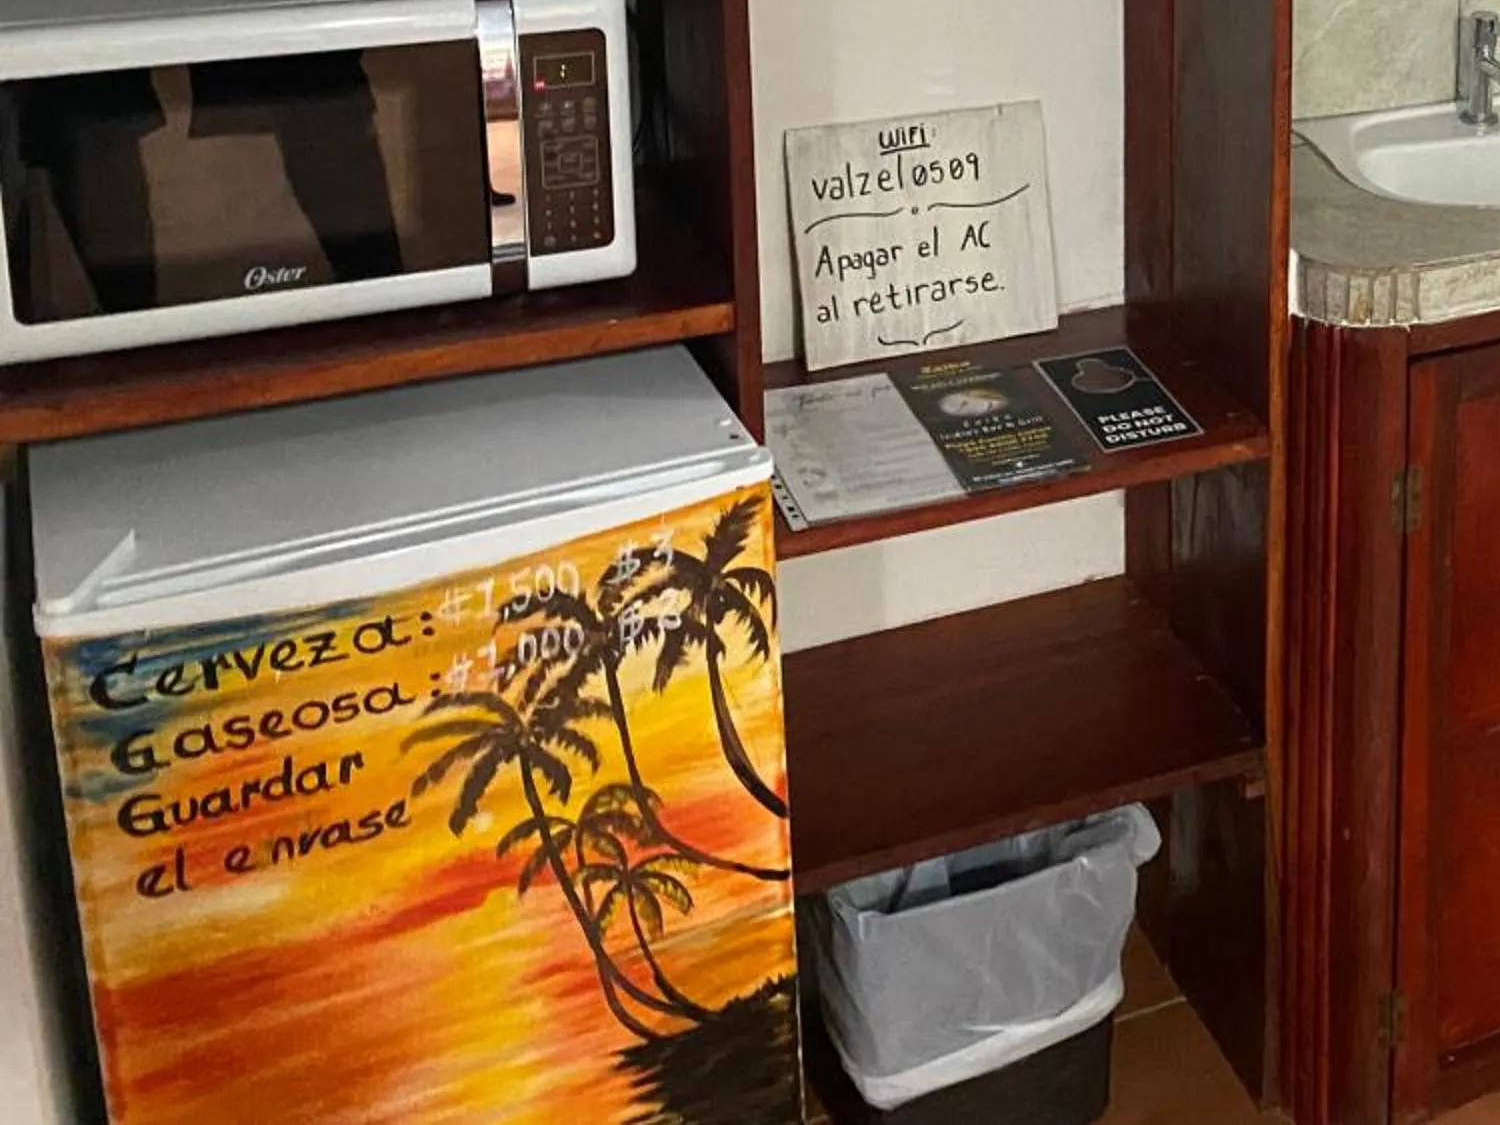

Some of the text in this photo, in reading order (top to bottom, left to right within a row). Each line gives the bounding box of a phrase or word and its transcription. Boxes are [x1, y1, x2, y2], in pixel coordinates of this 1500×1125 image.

[815, 221, 993, 281] Apagar el AC
[244, 266, 307, 290] Oster
[816, 271, 1005, 323] al retirarse.
[1097, 406, 1165, 424] PLEASE
[1102, 413, 1174, 434] DO NOT
[1105, 422, 1187, 444] DISTURB
[89, 611, 436, 710] Cerveza:
[111, 671, 442, 775] Gaseosa:
[117, 752, 365, 838] Guardar
[136, 847, 192, 899] el
